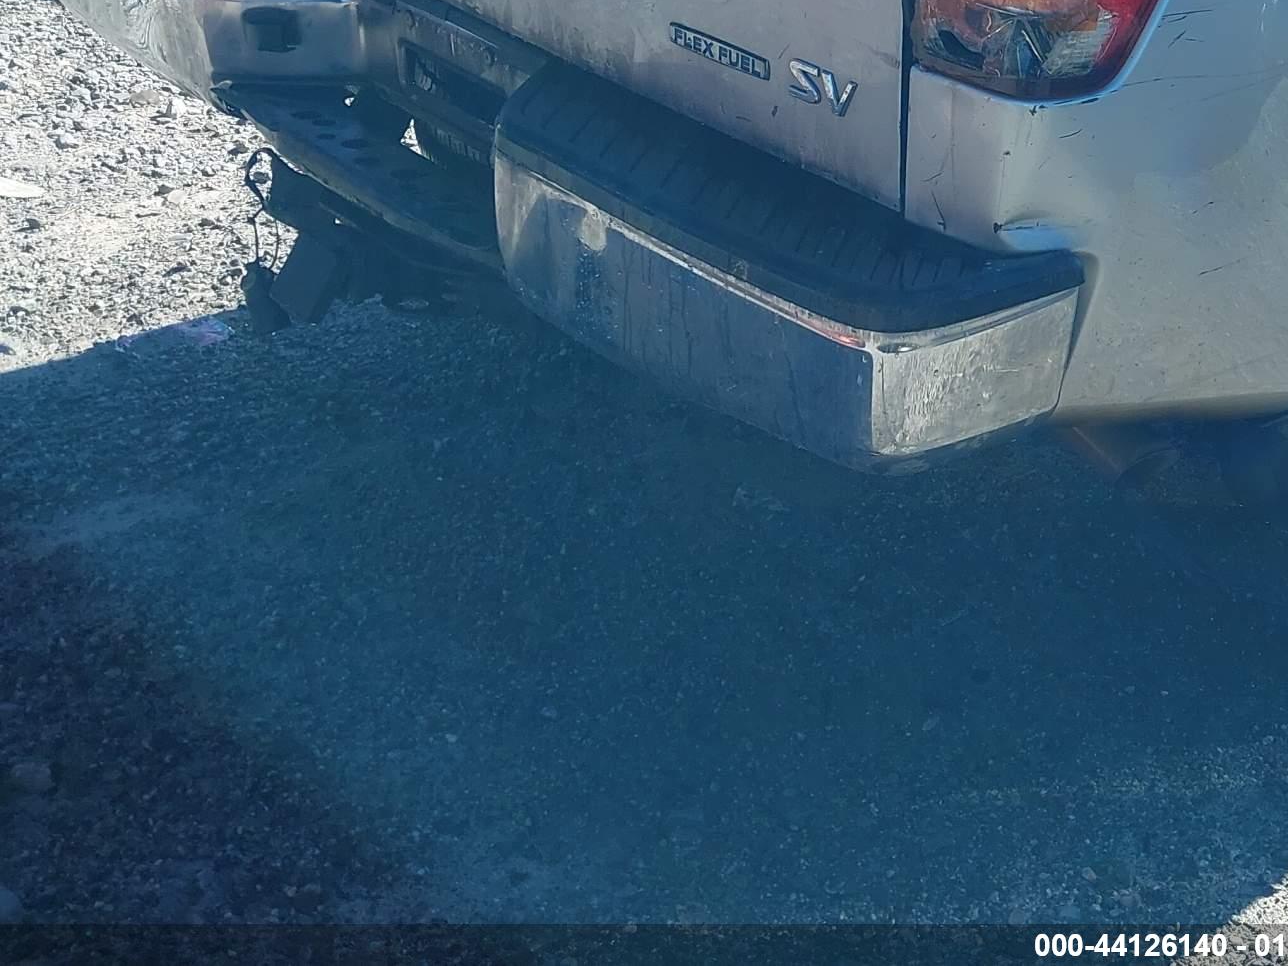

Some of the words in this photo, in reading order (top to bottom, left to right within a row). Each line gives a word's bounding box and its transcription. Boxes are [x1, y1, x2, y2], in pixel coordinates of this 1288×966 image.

[673, 28, 714, 59] FLEX
[717, 45, 764, 78] FUEL
[787, 57, 858, 117] SV
